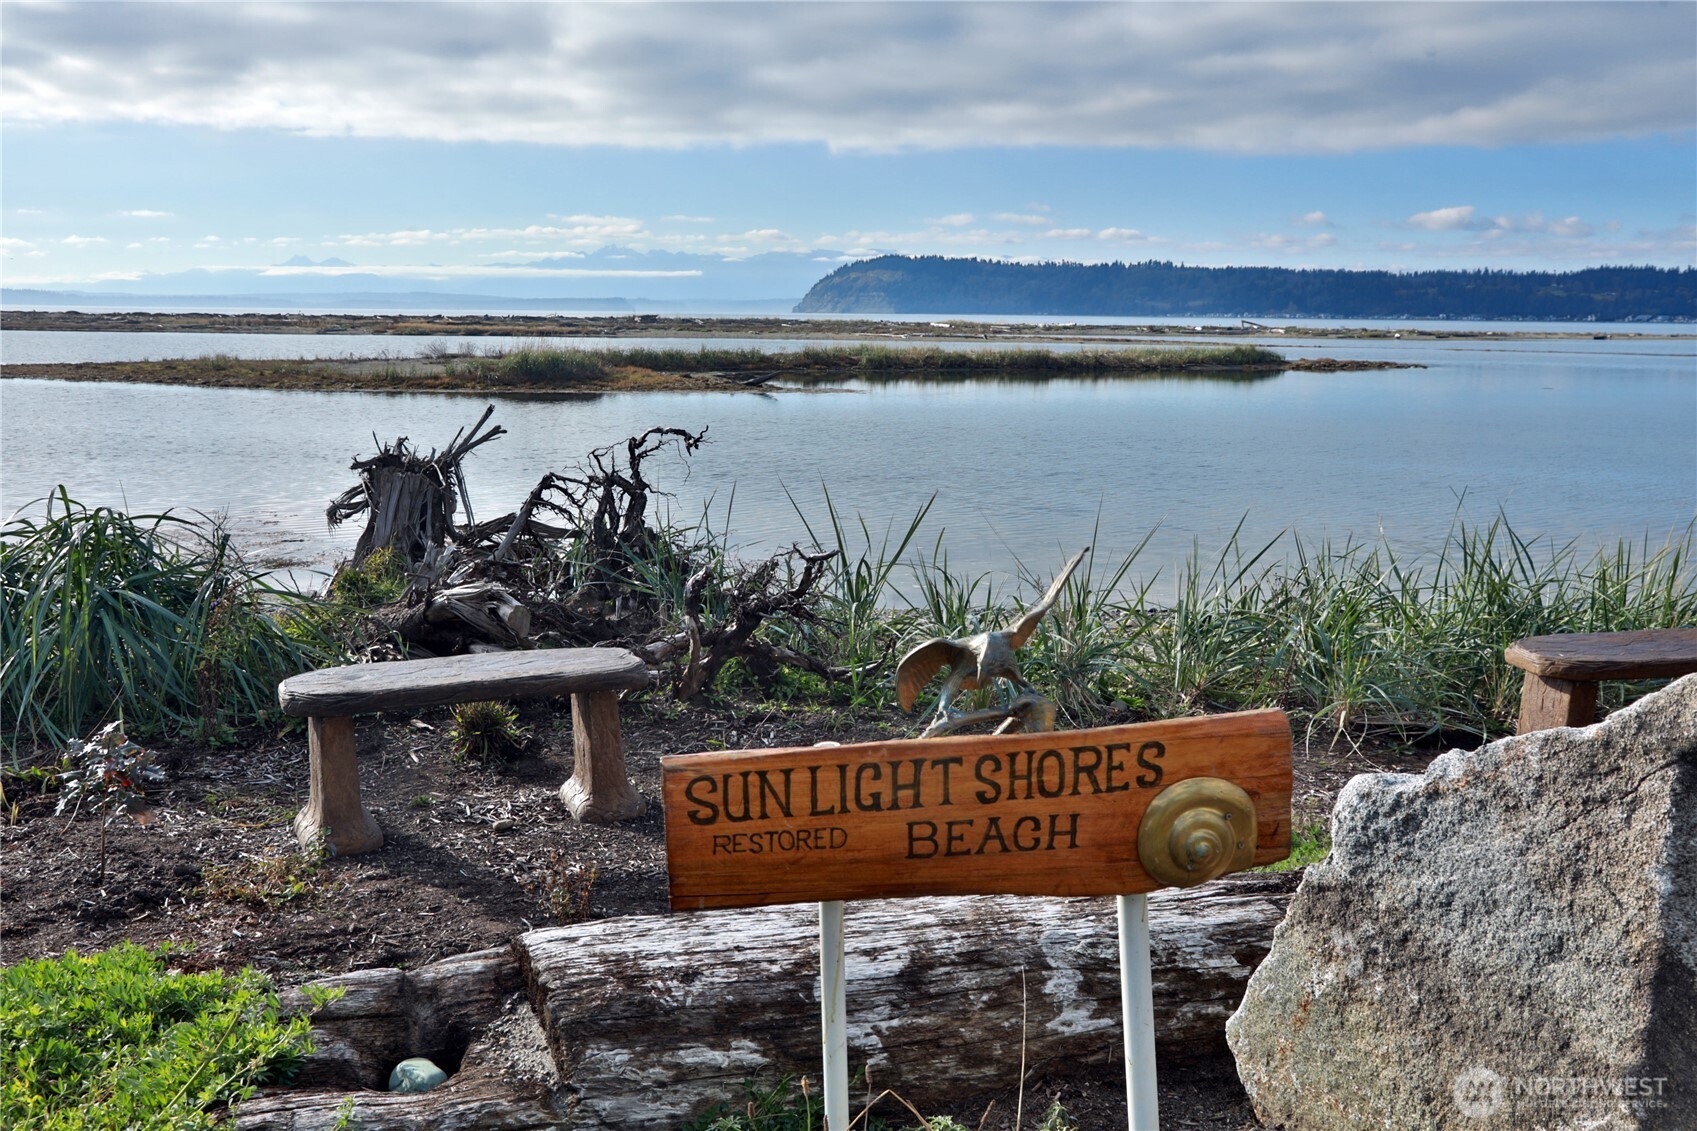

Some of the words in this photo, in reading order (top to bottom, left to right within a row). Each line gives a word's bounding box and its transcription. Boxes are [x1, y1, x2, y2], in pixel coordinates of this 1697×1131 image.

[974, 740, 1166, 805] SHORES
[712, 826, 848, 855] RESTORED
[904, 813, 1081, 859] BEACH
